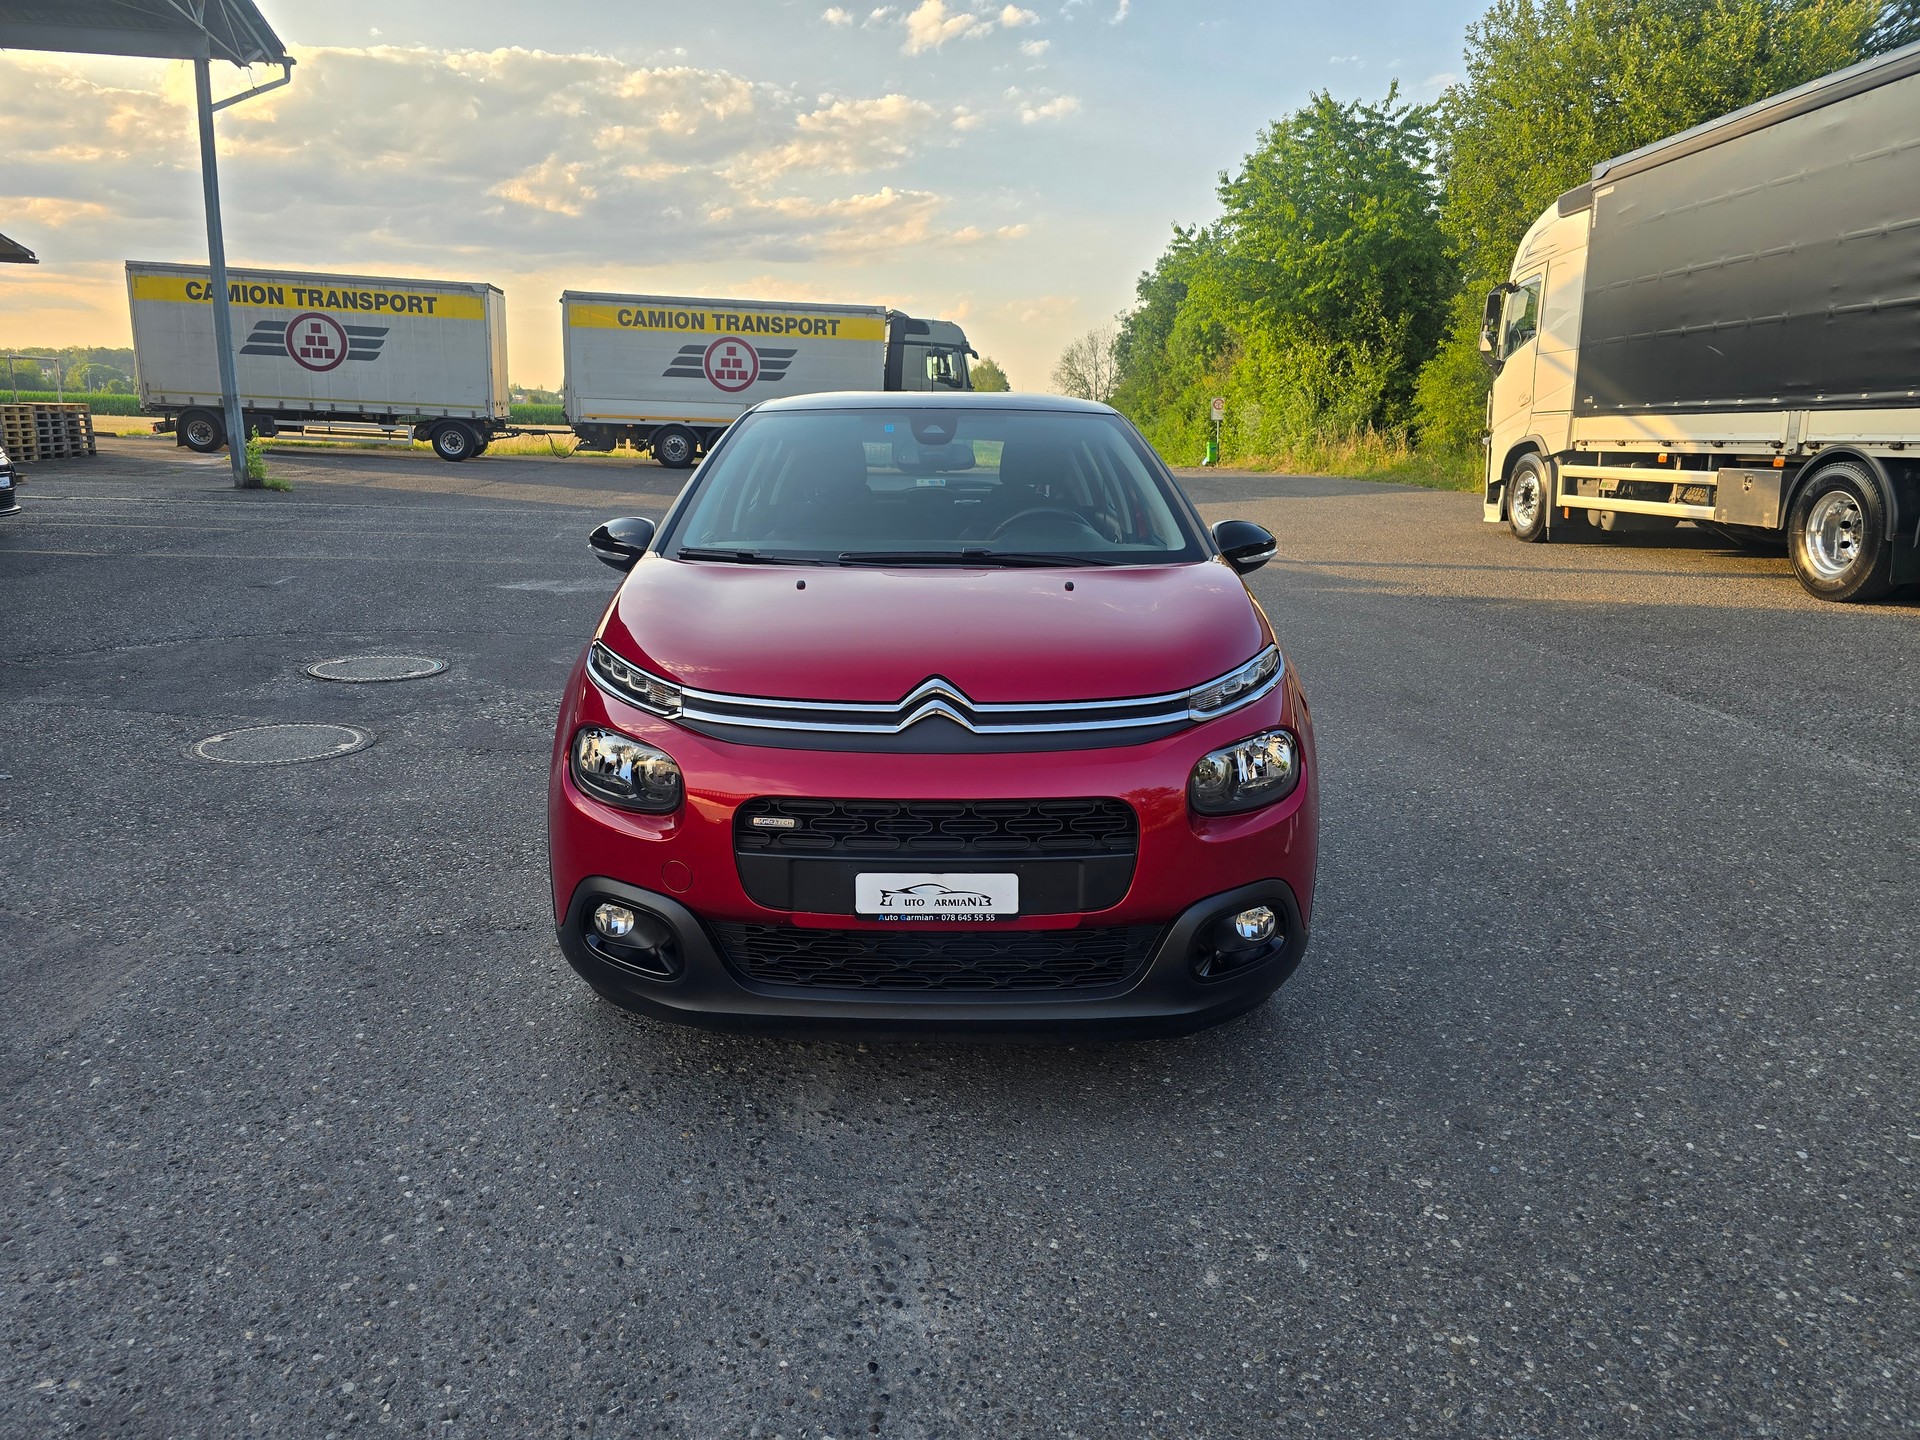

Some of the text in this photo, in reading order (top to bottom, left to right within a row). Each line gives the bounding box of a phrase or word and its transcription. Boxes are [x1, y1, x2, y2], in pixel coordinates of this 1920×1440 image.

[292, 288, 437, 314] TRANSPORT
[617, 309, 840, 336] CAMION TRANSPORT
